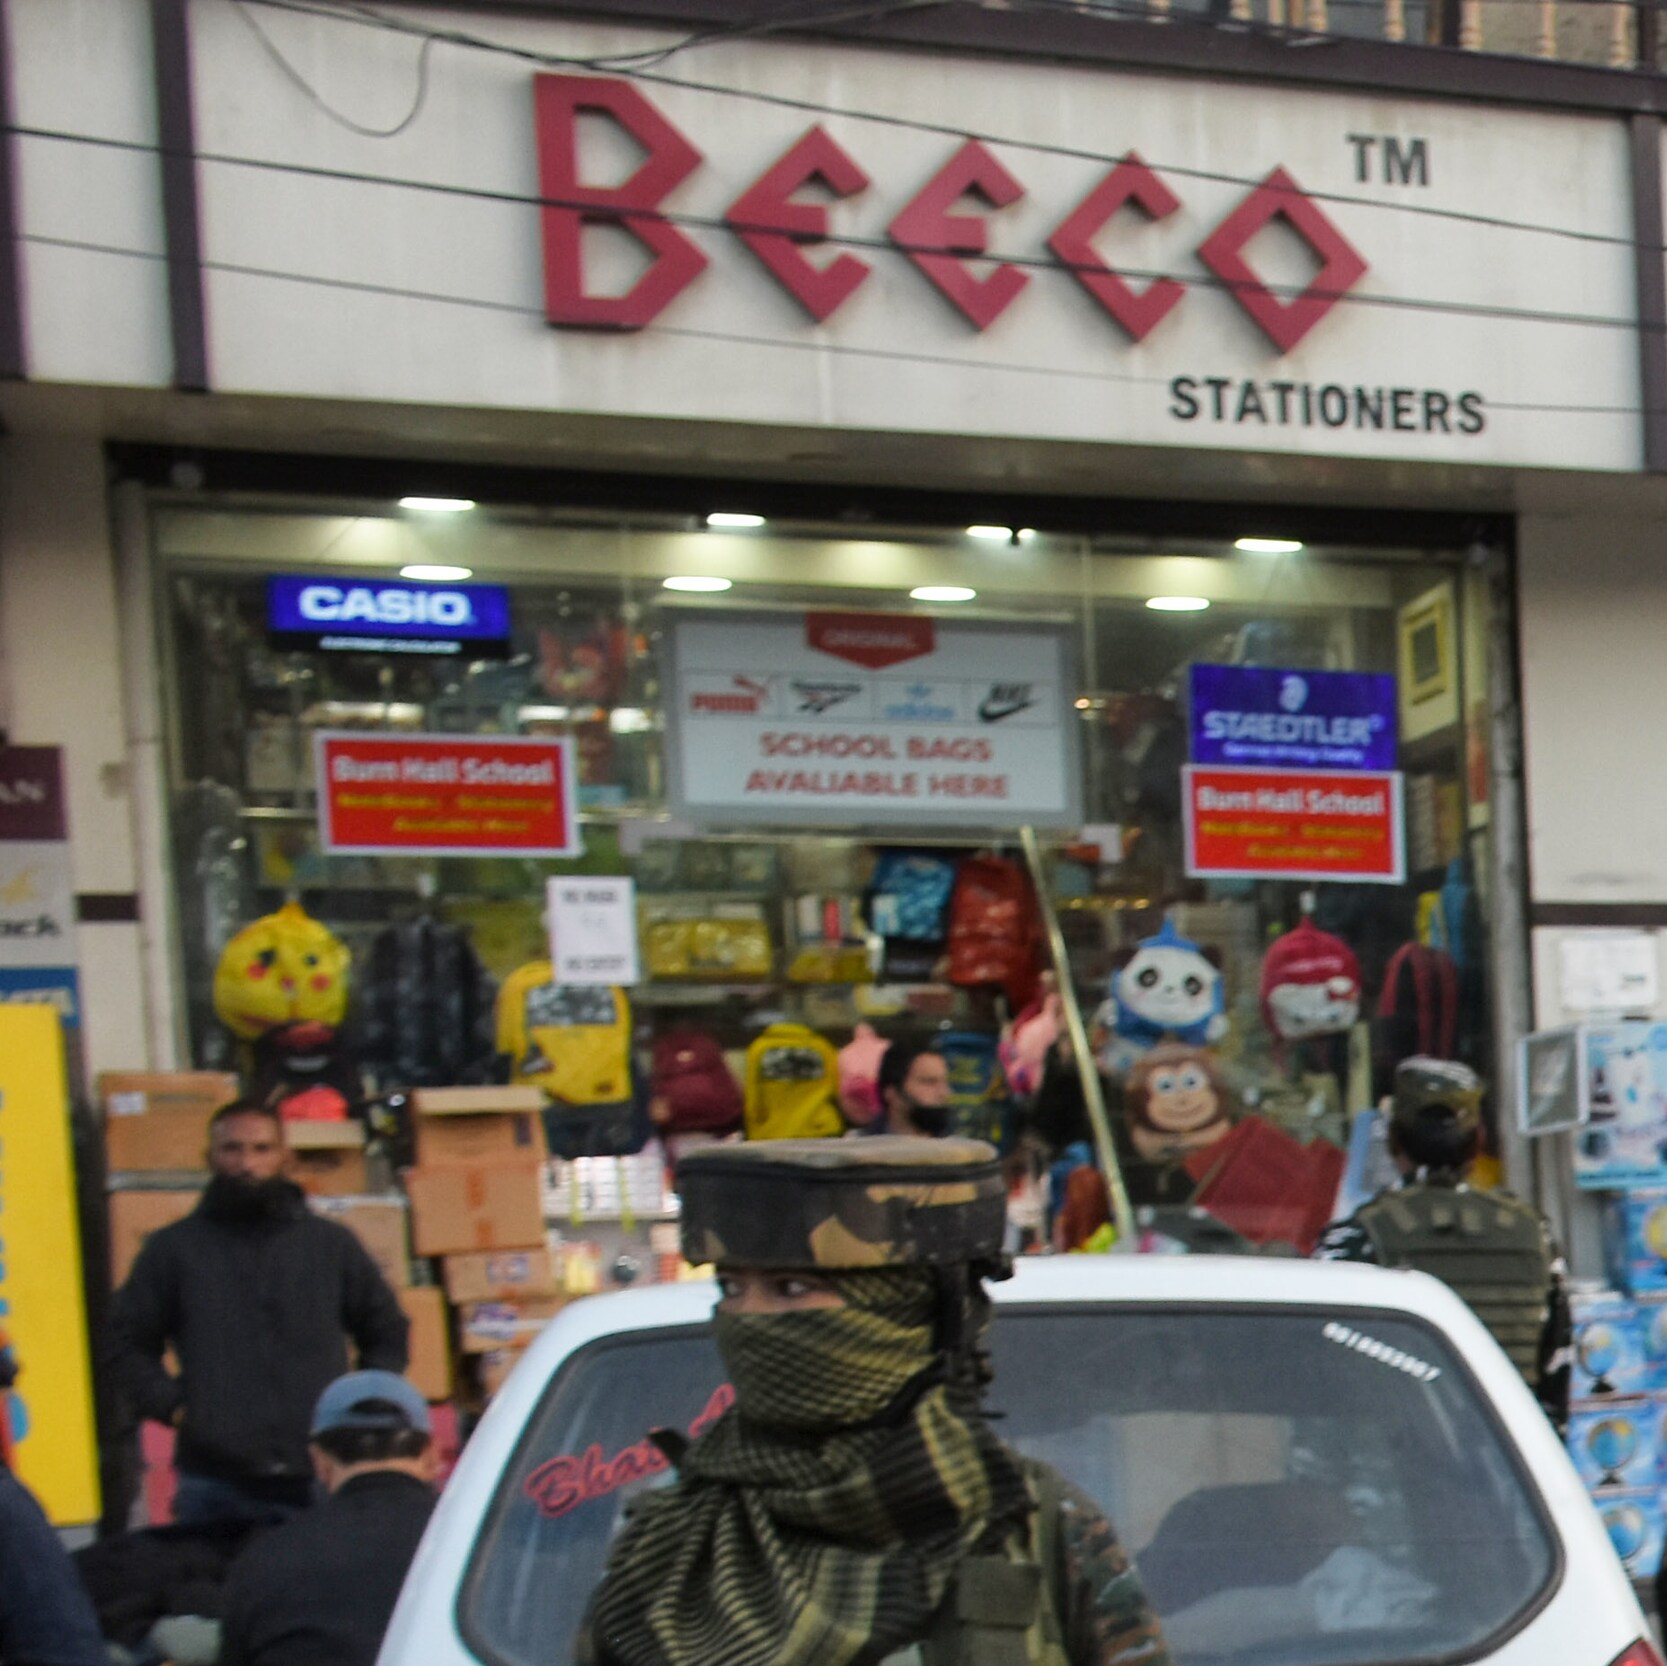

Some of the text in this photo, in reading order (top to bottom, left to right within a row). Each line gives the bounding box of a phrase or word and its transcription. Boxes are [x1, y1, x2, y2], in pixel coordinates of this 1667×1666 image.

[1347, 134, 1430, 188] TM
[1168, 377, 1486, 434] STATIONERS
[299, 586, 472, 626] CASIO
[1203, 710, 1372, 747] STAEDTLER
[760, 732, 993, 762] SCHOOL BAGS
[461, 758, 554, 786] School
[929, 774, 1010, 799] HERE
[1307, 790, 1385, 816] School
